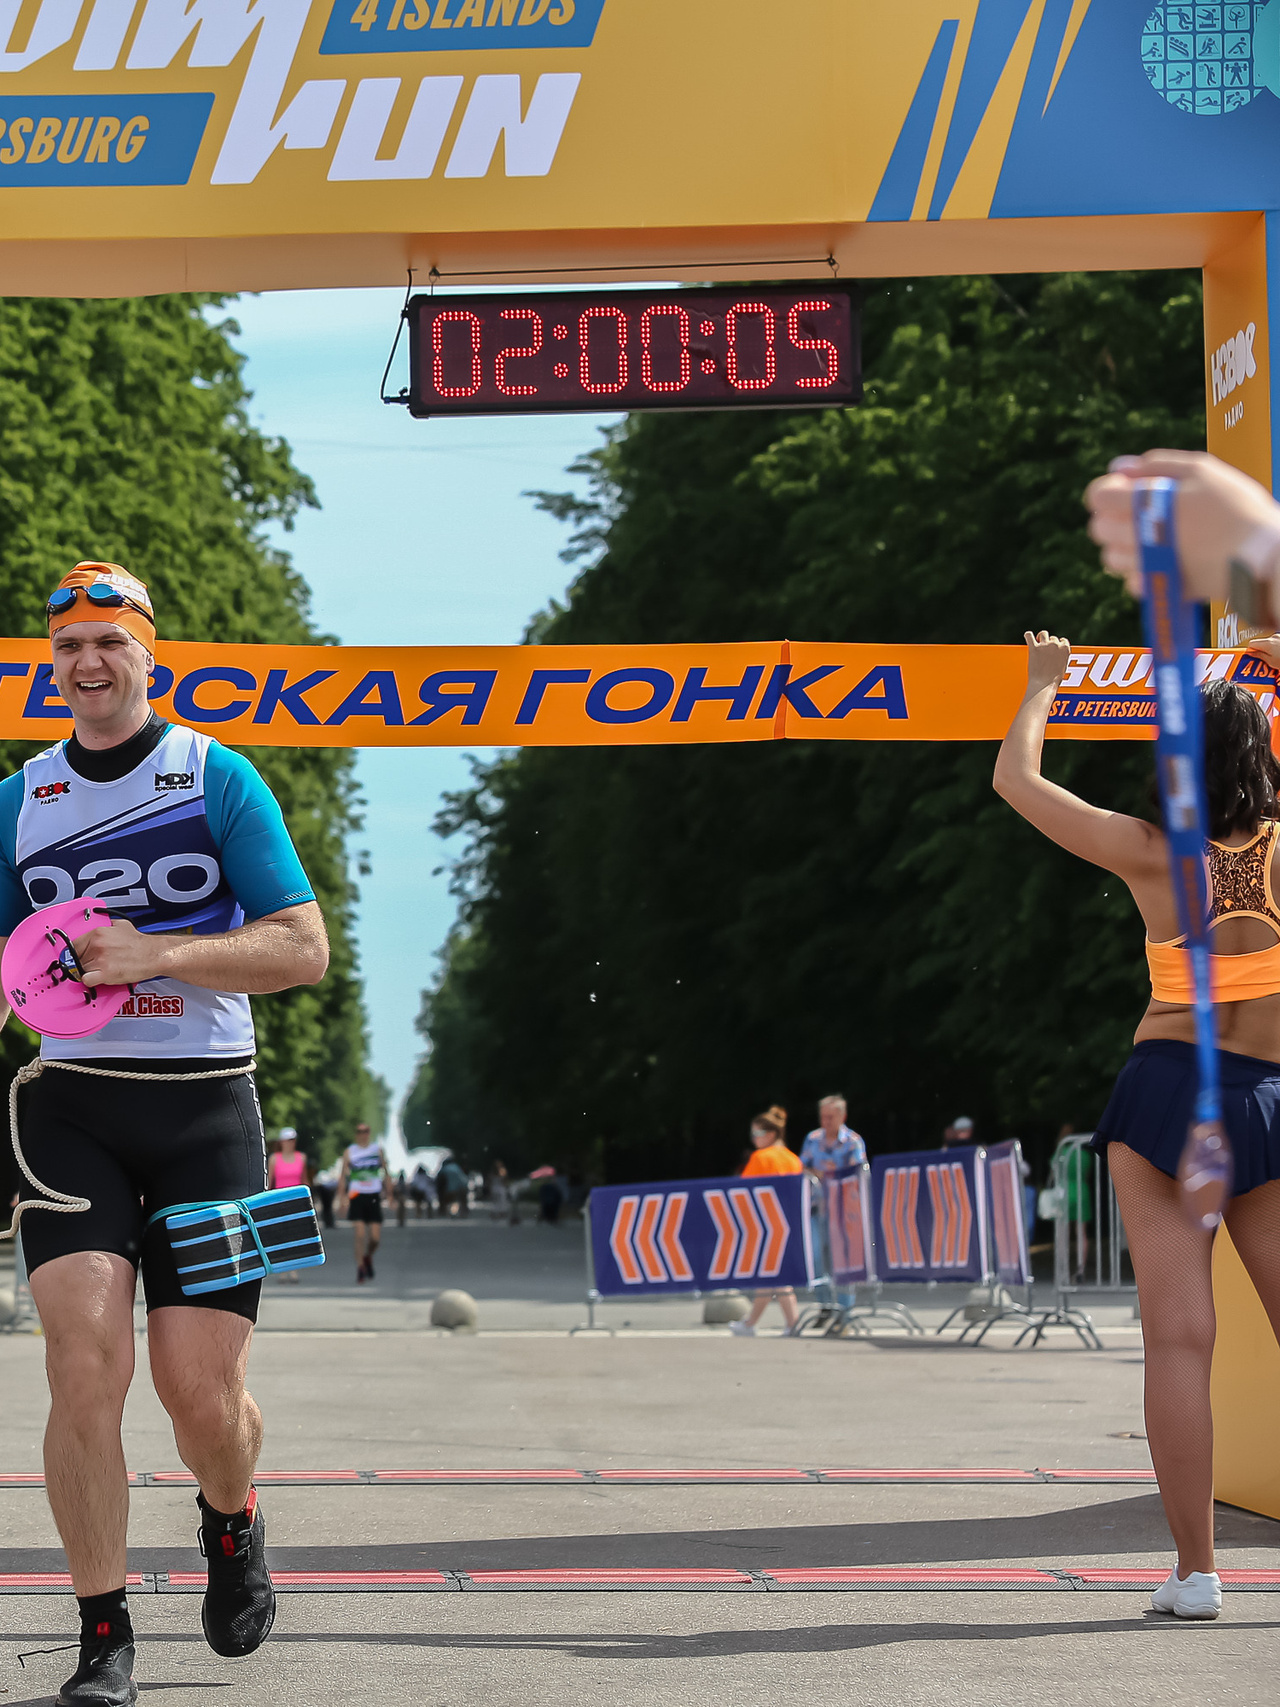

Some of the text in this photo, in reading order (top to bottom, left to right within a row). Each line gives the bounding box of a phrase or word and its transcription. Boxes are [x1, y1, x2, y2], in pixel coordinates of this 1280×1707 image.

[431, 300, 839, 397] 02:00:05
[515, 663, 910, 726] ГОНКА
[1073, 700, 1158, 718] PETERSBUR
[22, 853, 221, 911] 020
[137, 995, 181, 1016] Class
